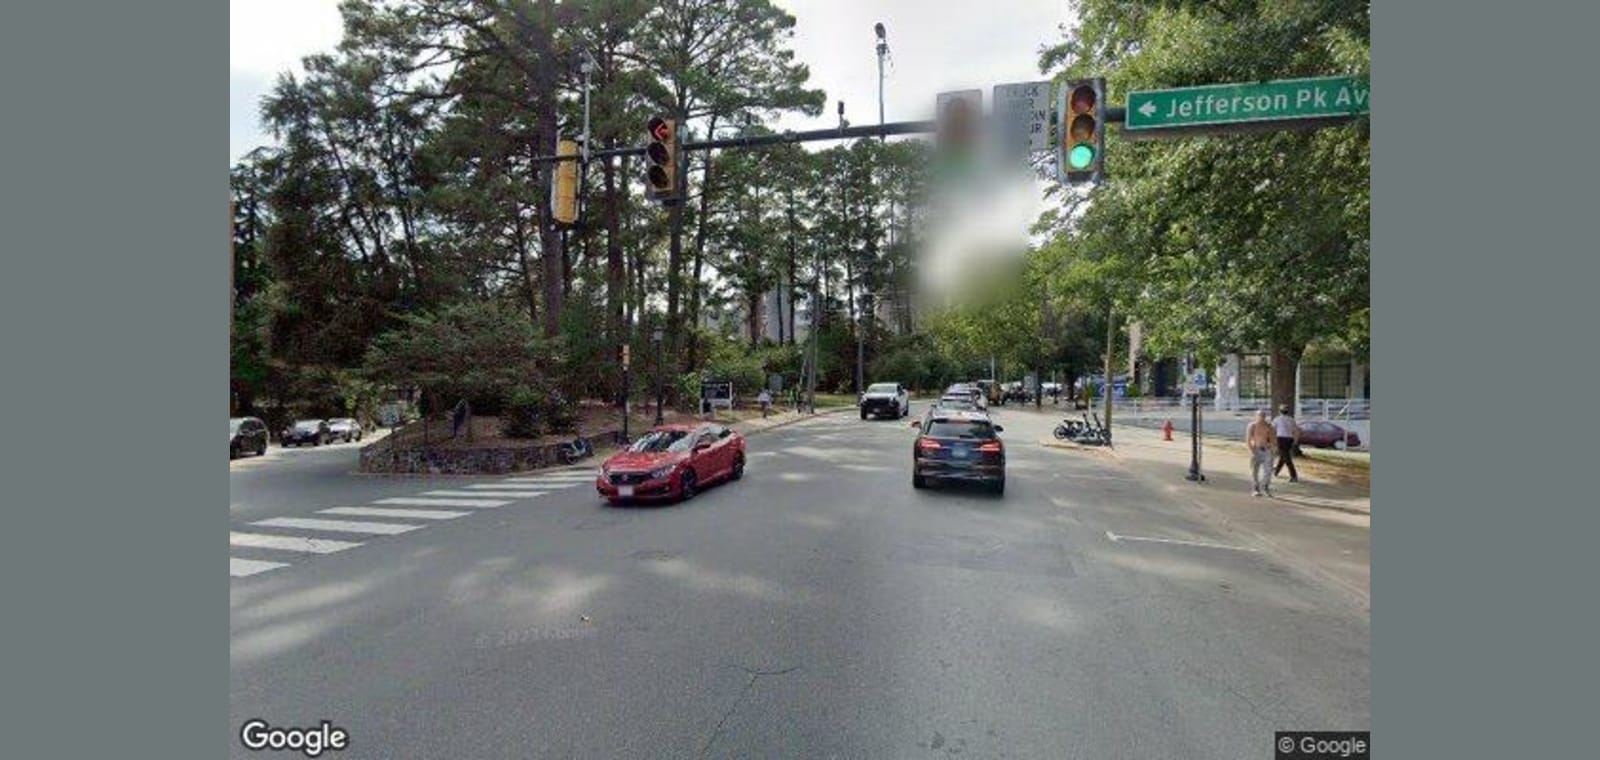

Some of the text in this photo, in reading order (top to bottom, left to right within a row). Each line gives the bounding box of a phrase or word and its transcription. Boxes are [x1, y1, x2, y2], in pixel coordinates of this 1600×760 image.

[1165, 86, 1369, 118] Jefferson Pk Av
